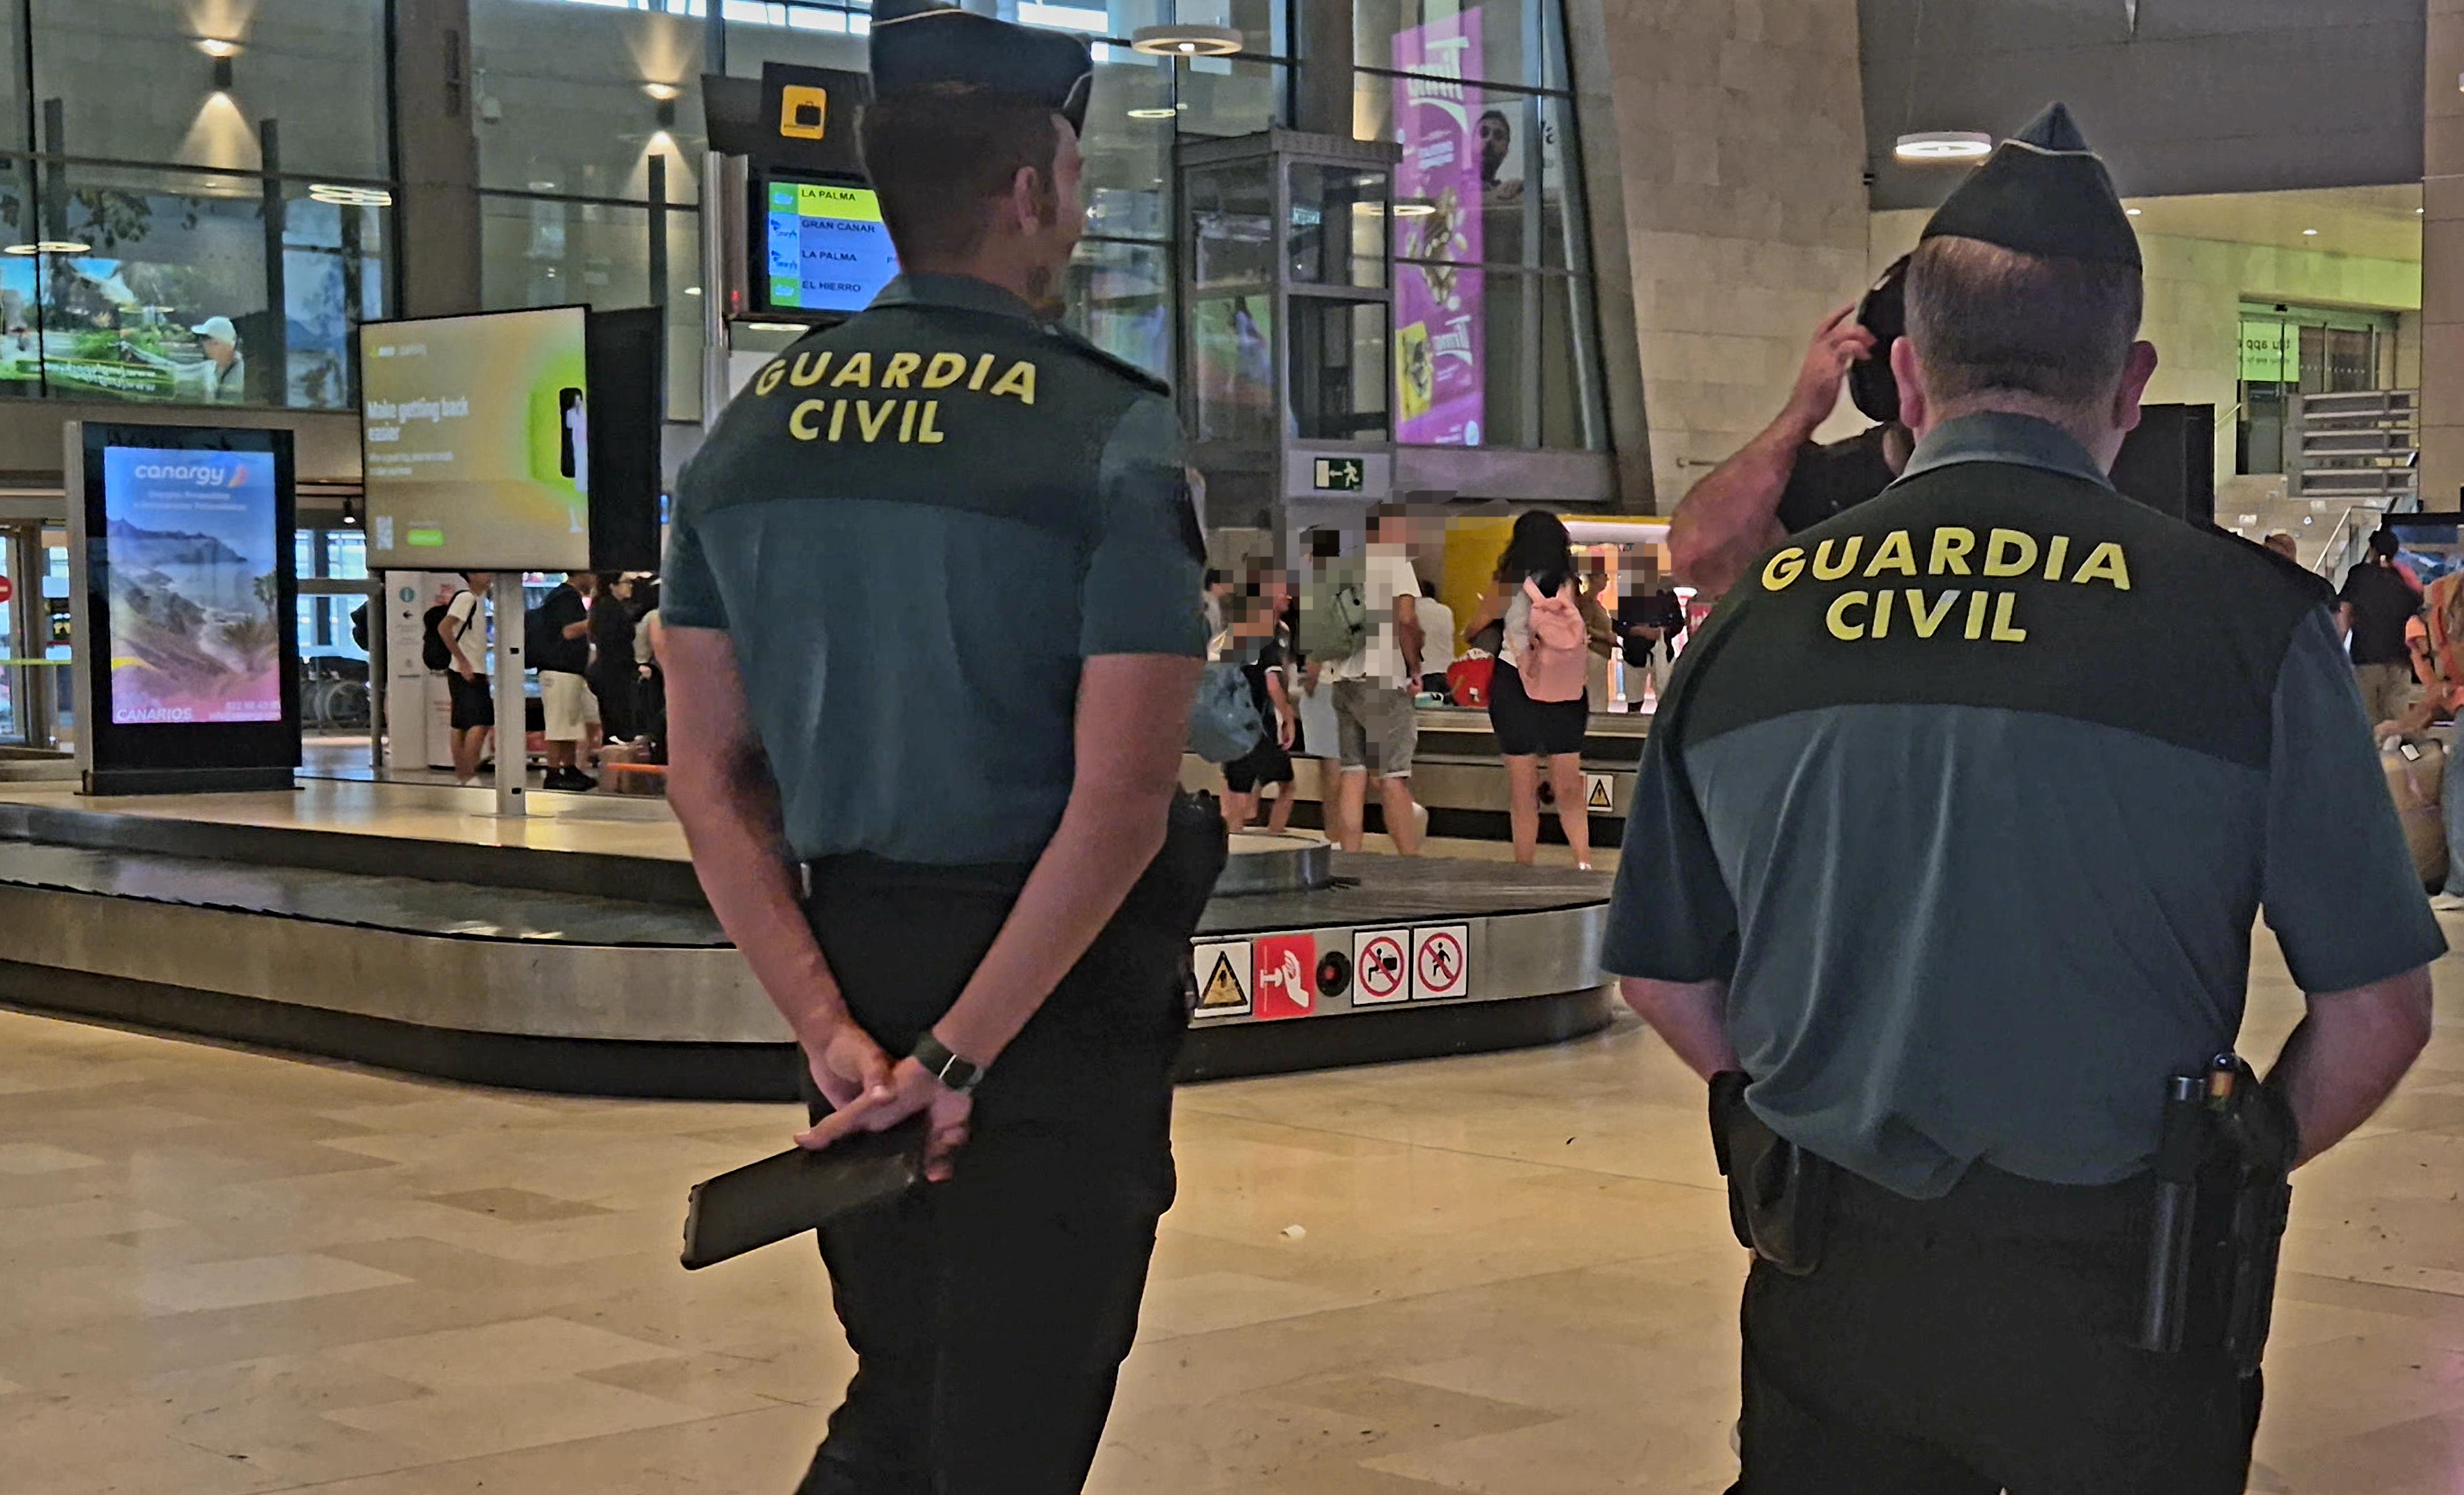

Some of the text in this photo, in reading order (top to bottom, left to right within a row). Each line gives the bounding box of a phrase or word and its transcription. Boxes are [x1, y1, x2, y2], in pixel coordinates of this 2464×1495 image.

[801, 189, 856, 201] LA PALMA
[801, 220, 834, 229] GRAN
[802, 250, 858, 262] LA PALMA
[802, 280, 861, 292] EL HIERRO
[755, 351, 1036, 405] GUARDIA
[789, 399, 944, 443] CIVIL
[135, 465, 225, 486] canargy
[1761, 527, 2131, 591] GUARDIA
[1826, 589, 2026, 642] CIVIL
[117, 707, 193, 722] CANARIOS
